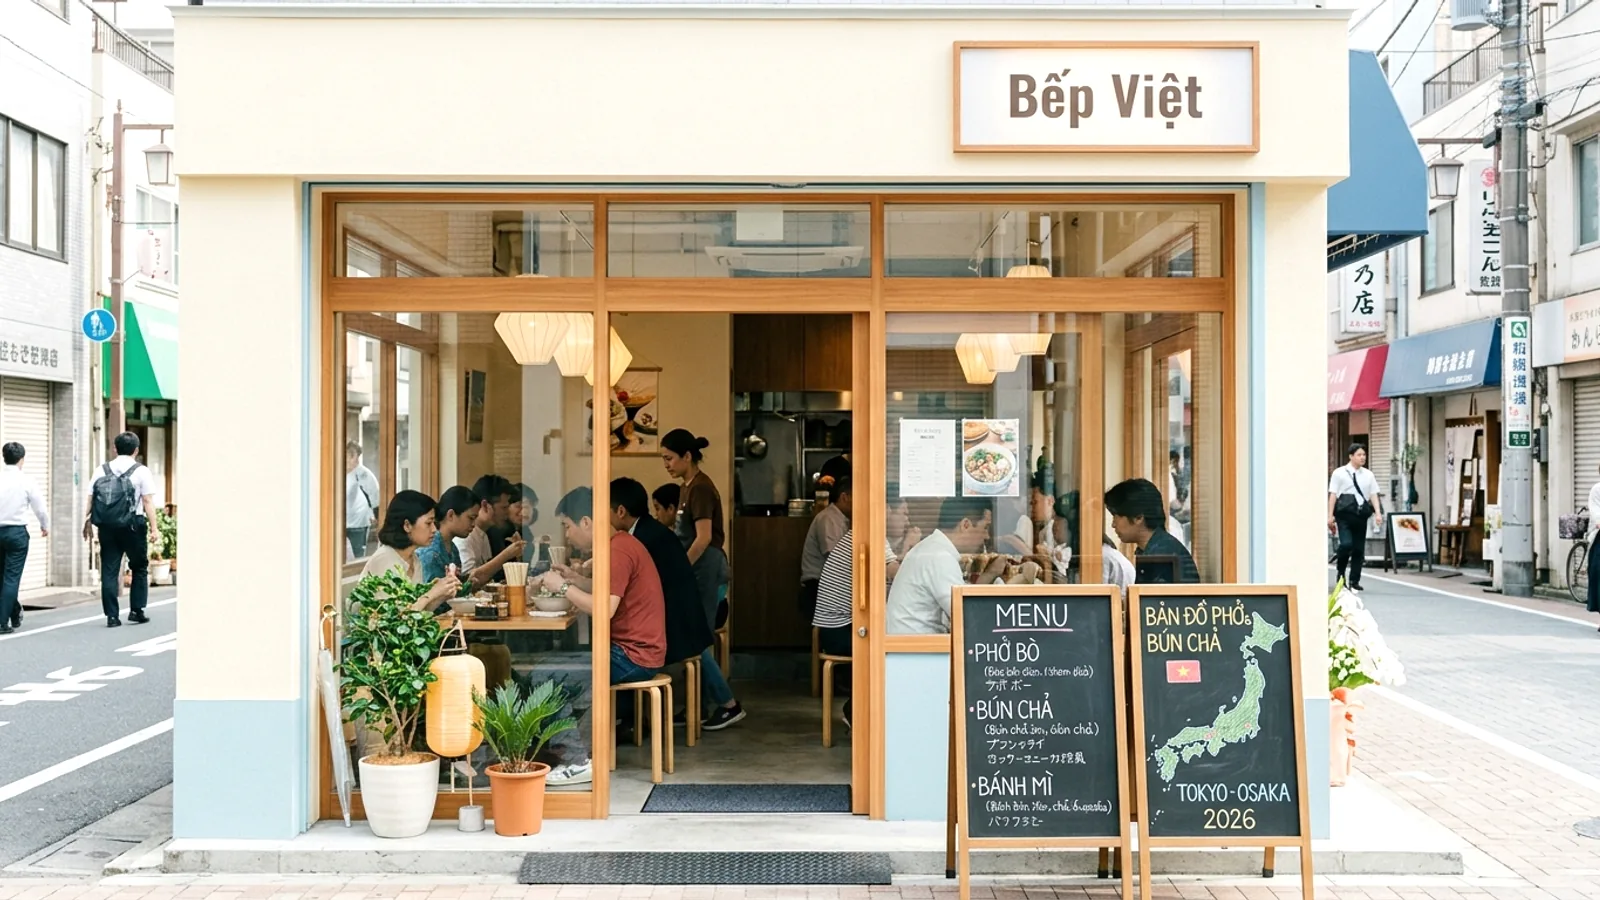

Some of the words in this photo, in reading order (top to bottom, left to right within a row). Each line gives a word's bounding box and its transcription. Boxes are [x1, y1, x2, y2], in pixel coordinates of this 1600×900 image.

[1009, 69, 1094, 128] Bếp
[1111, 73, 1203, 129] Việt
[996, 603, 1068, 627] MENU
[1145, 601, 1181, 626] BẢN
[975, 635, 1012, 662] PHỞ
[1016, 637, 1040, 662] BÒ
[1147, 628, 1183, 653] BÚN
[1187, 626, 1222, 653] CHẢ
[976, 695, 1013, 720] BÚN
[1017, 692, 1054, 720] CHẢ
[978, 770, 1027, 796] BÁNH
[1032, 770, 1054, 796] MÌ
[1203, 808, 1256, 830] 2026
